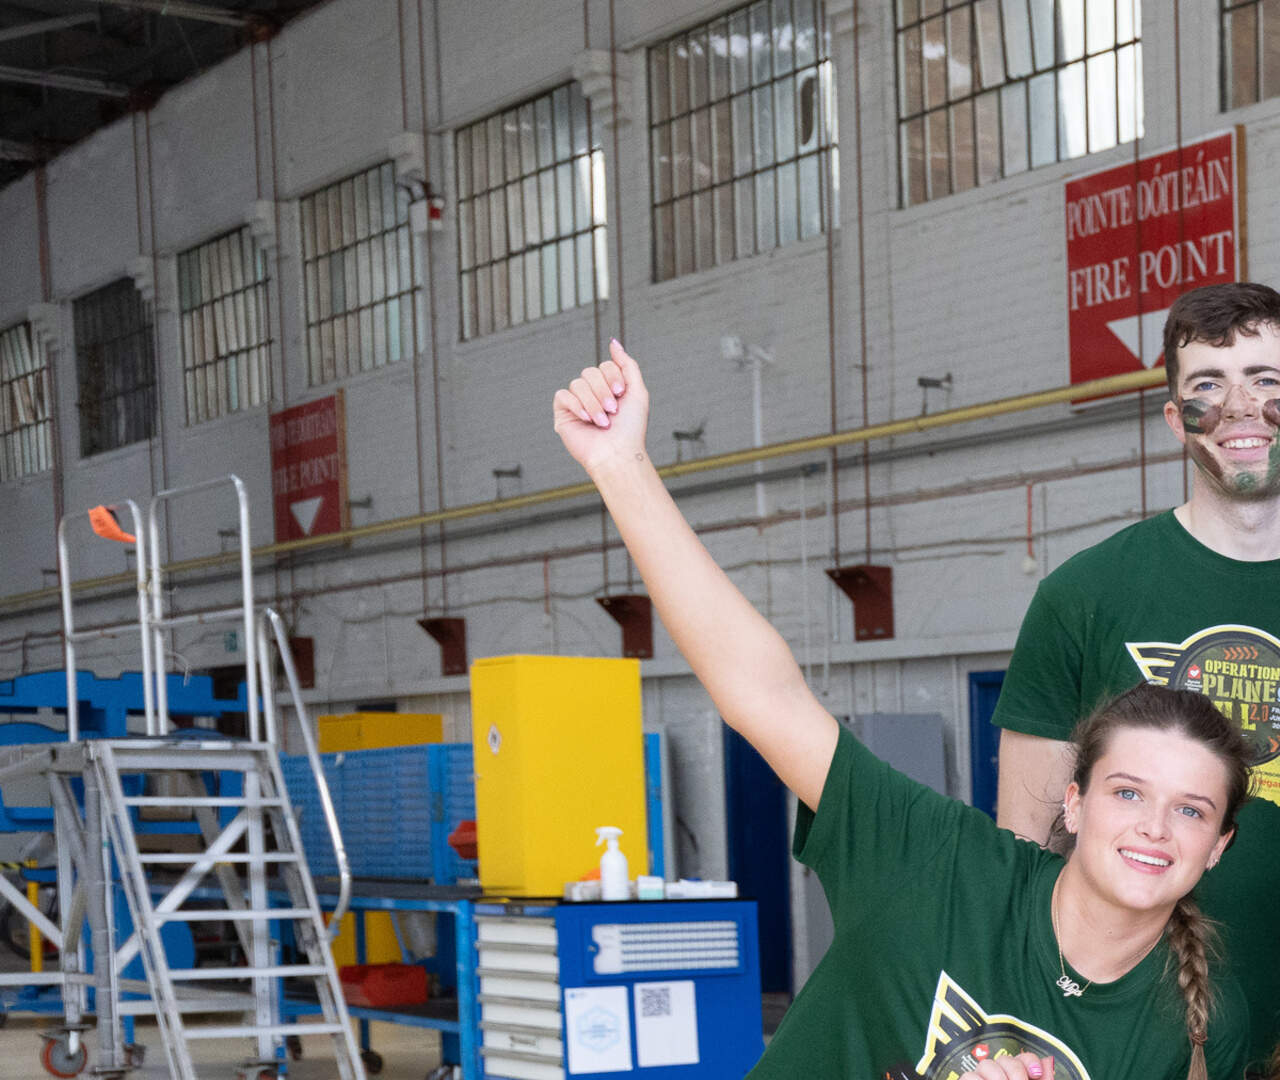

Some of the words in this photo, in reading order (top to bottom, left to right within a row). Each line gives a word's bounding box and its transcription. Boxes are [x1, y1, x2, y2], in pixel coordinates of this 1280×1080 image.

[1067, 184, 1132, 241] POINTE
[1071, 256, 1131, 311] FIRE
[1139, 230, 1233, 294] POINT
[1204, 659, 1280, 681] OPERATION
[1201, 673, 1277, 703] PLANE
[1249, 703, 1270, 722] 2.0
